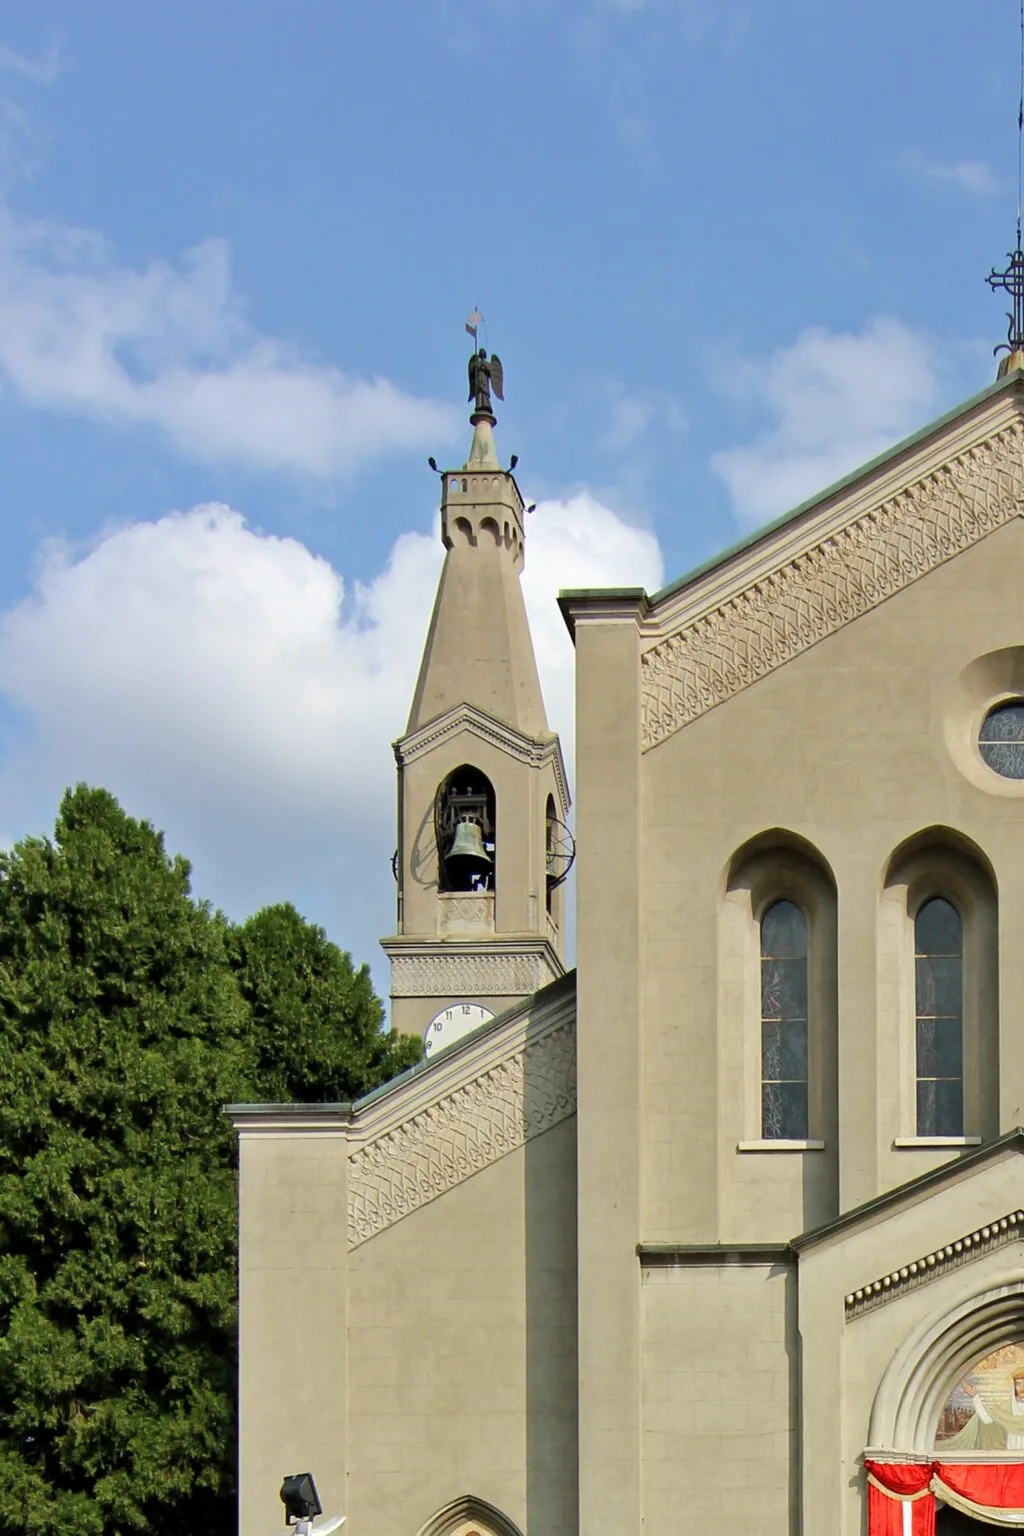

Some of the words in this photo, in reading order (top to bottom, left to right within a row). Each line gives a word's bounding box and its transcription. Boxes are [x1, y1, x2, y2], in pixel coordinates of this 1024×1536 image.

[462, 1005, 471, 1015] 12
[480, 1009, 484, 1019] 1
[446, 1011, 452, 1020] 11
[433, 1022, 442, 1032] 10
[426, 1041, 433, 1049] 9
